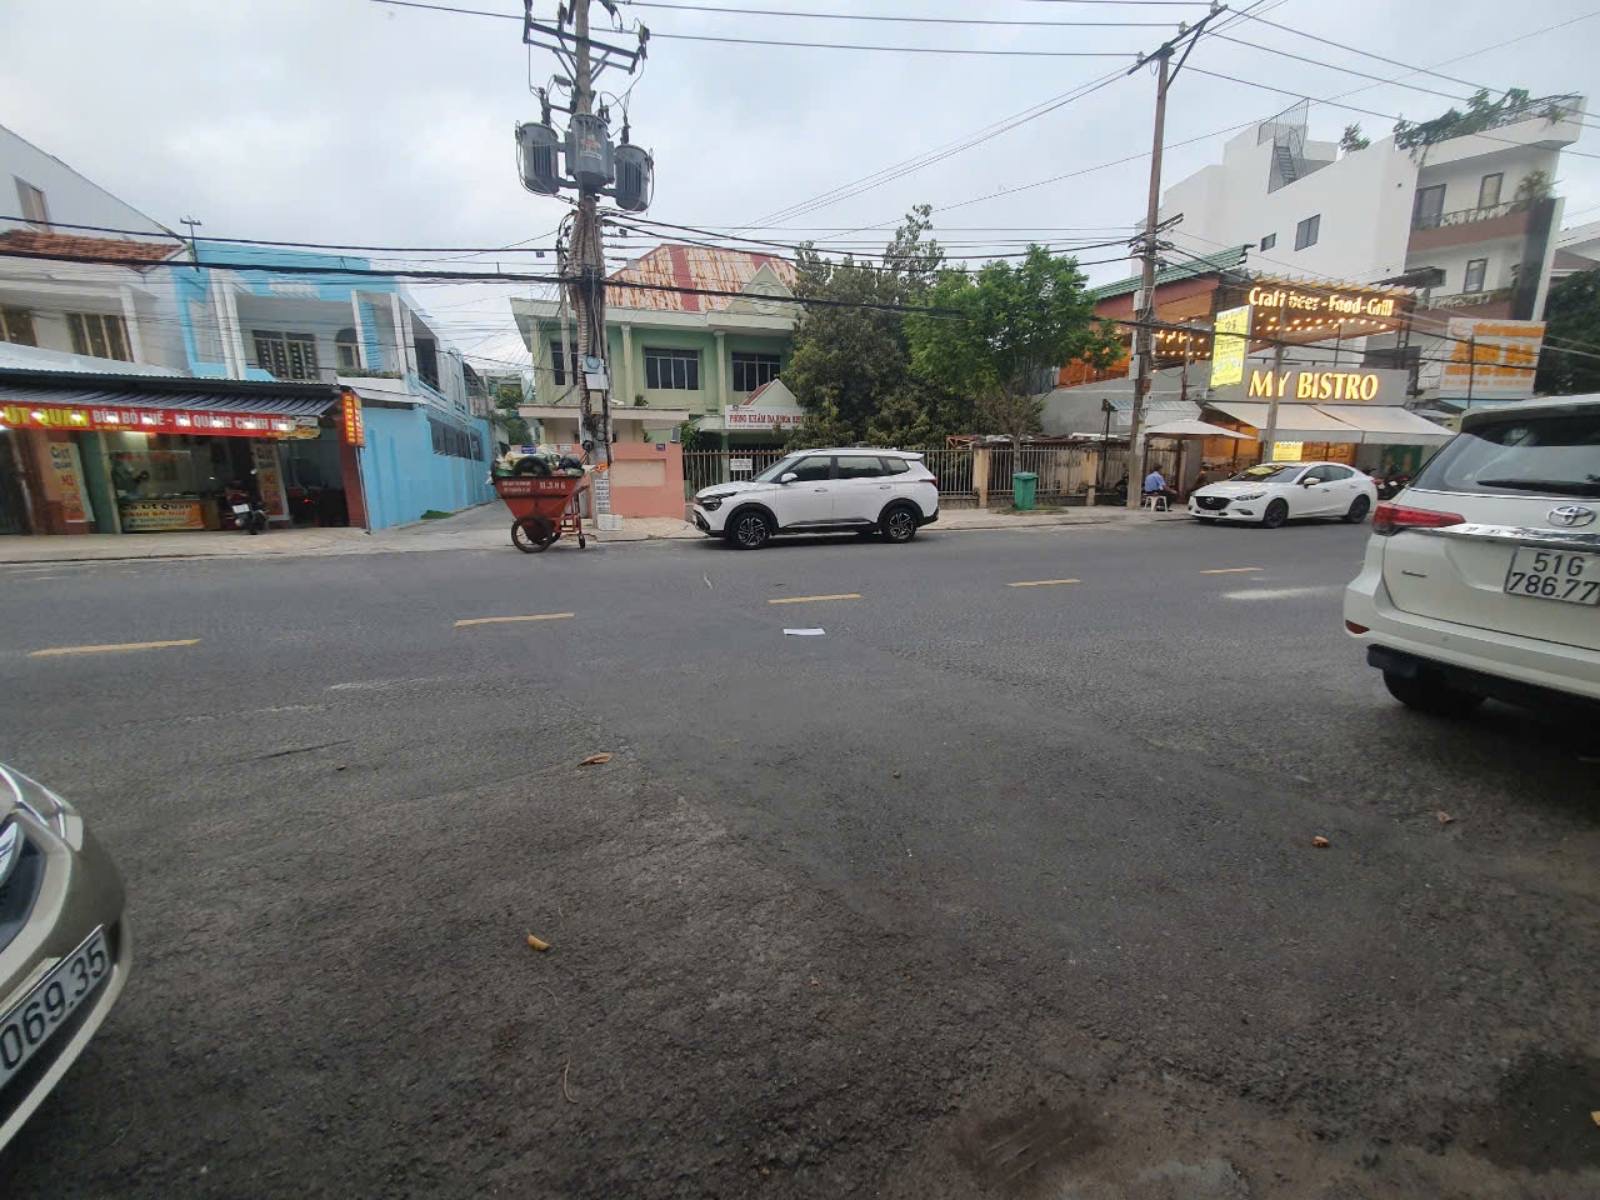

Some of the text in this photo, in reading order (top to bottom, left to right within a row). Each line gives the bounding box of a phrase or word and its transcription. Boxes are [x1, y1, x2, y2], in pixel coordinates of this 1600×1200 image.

[1249, 287, 1286, 307] Craft
[1249, 370, 1379, 401] MY BISTRO
[1533, 552, 1585, 577] 51G
[1508, 572, 1600, 601] 786.77
[0, 938, 106, 1070] 069.35
